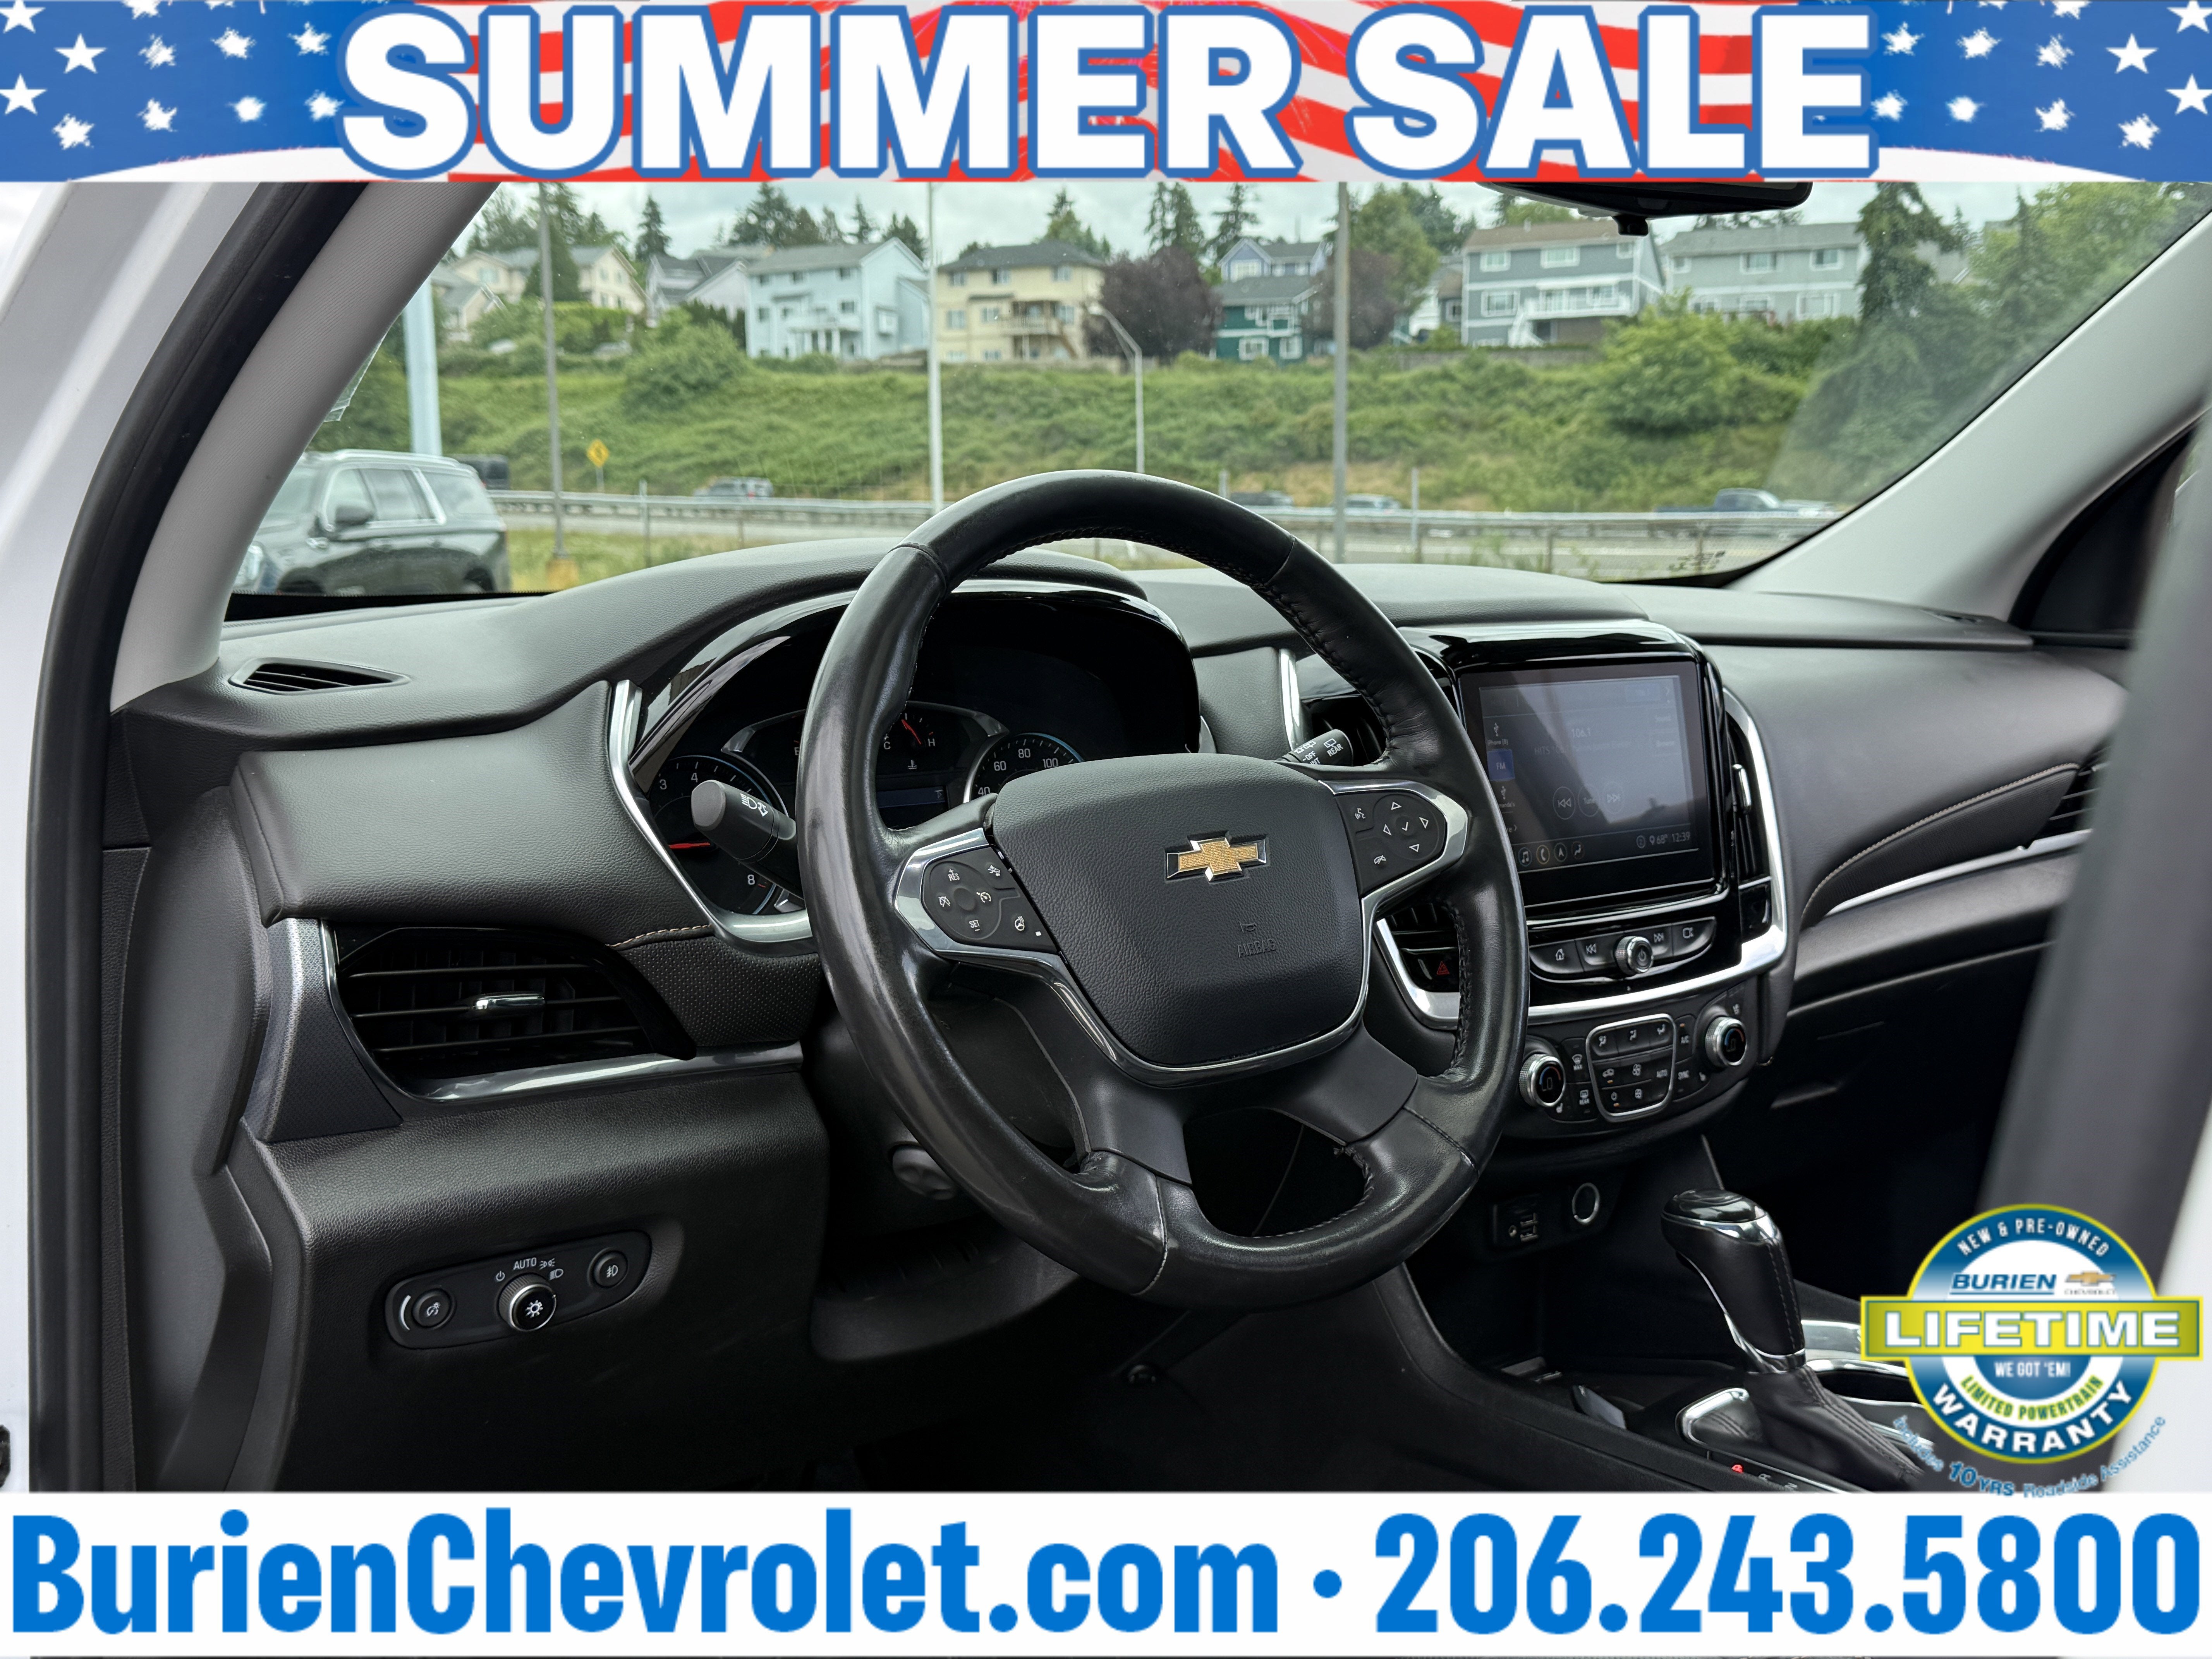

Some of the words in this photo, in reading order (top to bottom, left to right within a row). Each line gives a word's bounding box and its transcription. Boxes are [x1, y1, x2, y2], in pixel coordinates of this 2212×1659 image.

[883, 741, 891, 750] C
[927, 738, 936, 747] H
[1018, 748, 1031, 758] 80
[1327, 744, 1344, 757] REAR
[993, 760, 1007, 771] 60
[1042, 757, 1059, 768] 100
[1496, 762, 1506, 770] FM
[690, 772, 698, 783] 4
[659, 779, 667, 790] 3
[747, 874, 756, 885] 8
[948, 872, 960, 882] RES
[969, 919, 980, 929] SET
[1237, 938, 1276, 958] AIRBAG
[512, 1257, 537, 1271] AUTO
